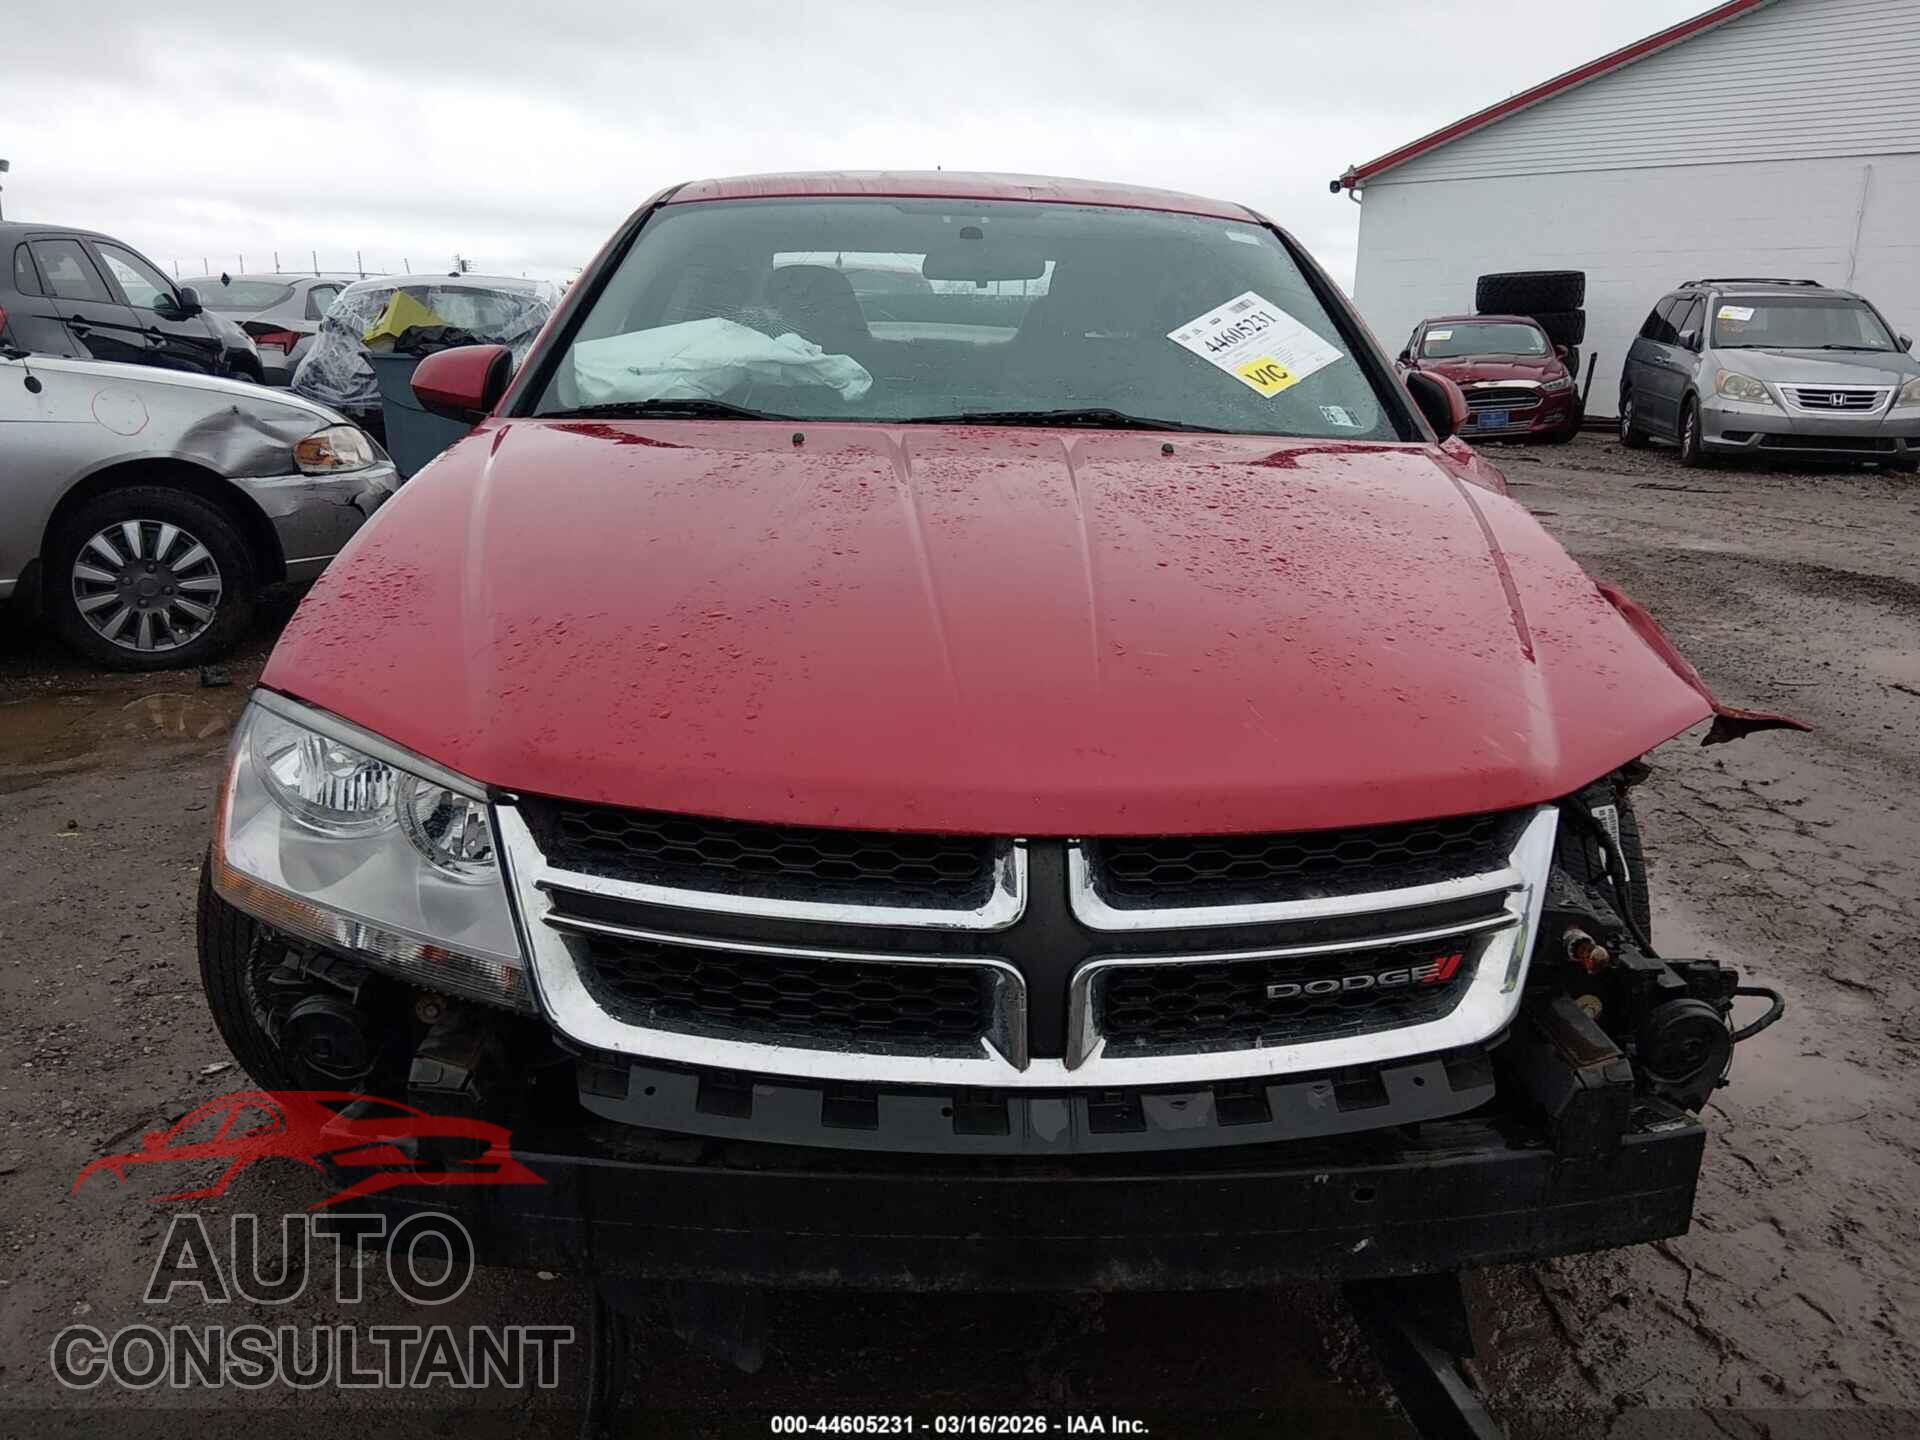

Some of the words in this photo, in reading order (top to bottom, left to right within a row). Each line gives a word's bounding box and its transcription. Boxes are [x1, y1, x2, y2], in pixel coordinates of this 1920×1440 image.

[1204, 311, 1277, 353] 44605231
[1245, 364, 1289, 386] VIC
[1266, 962, 1441, 999] DODGE
